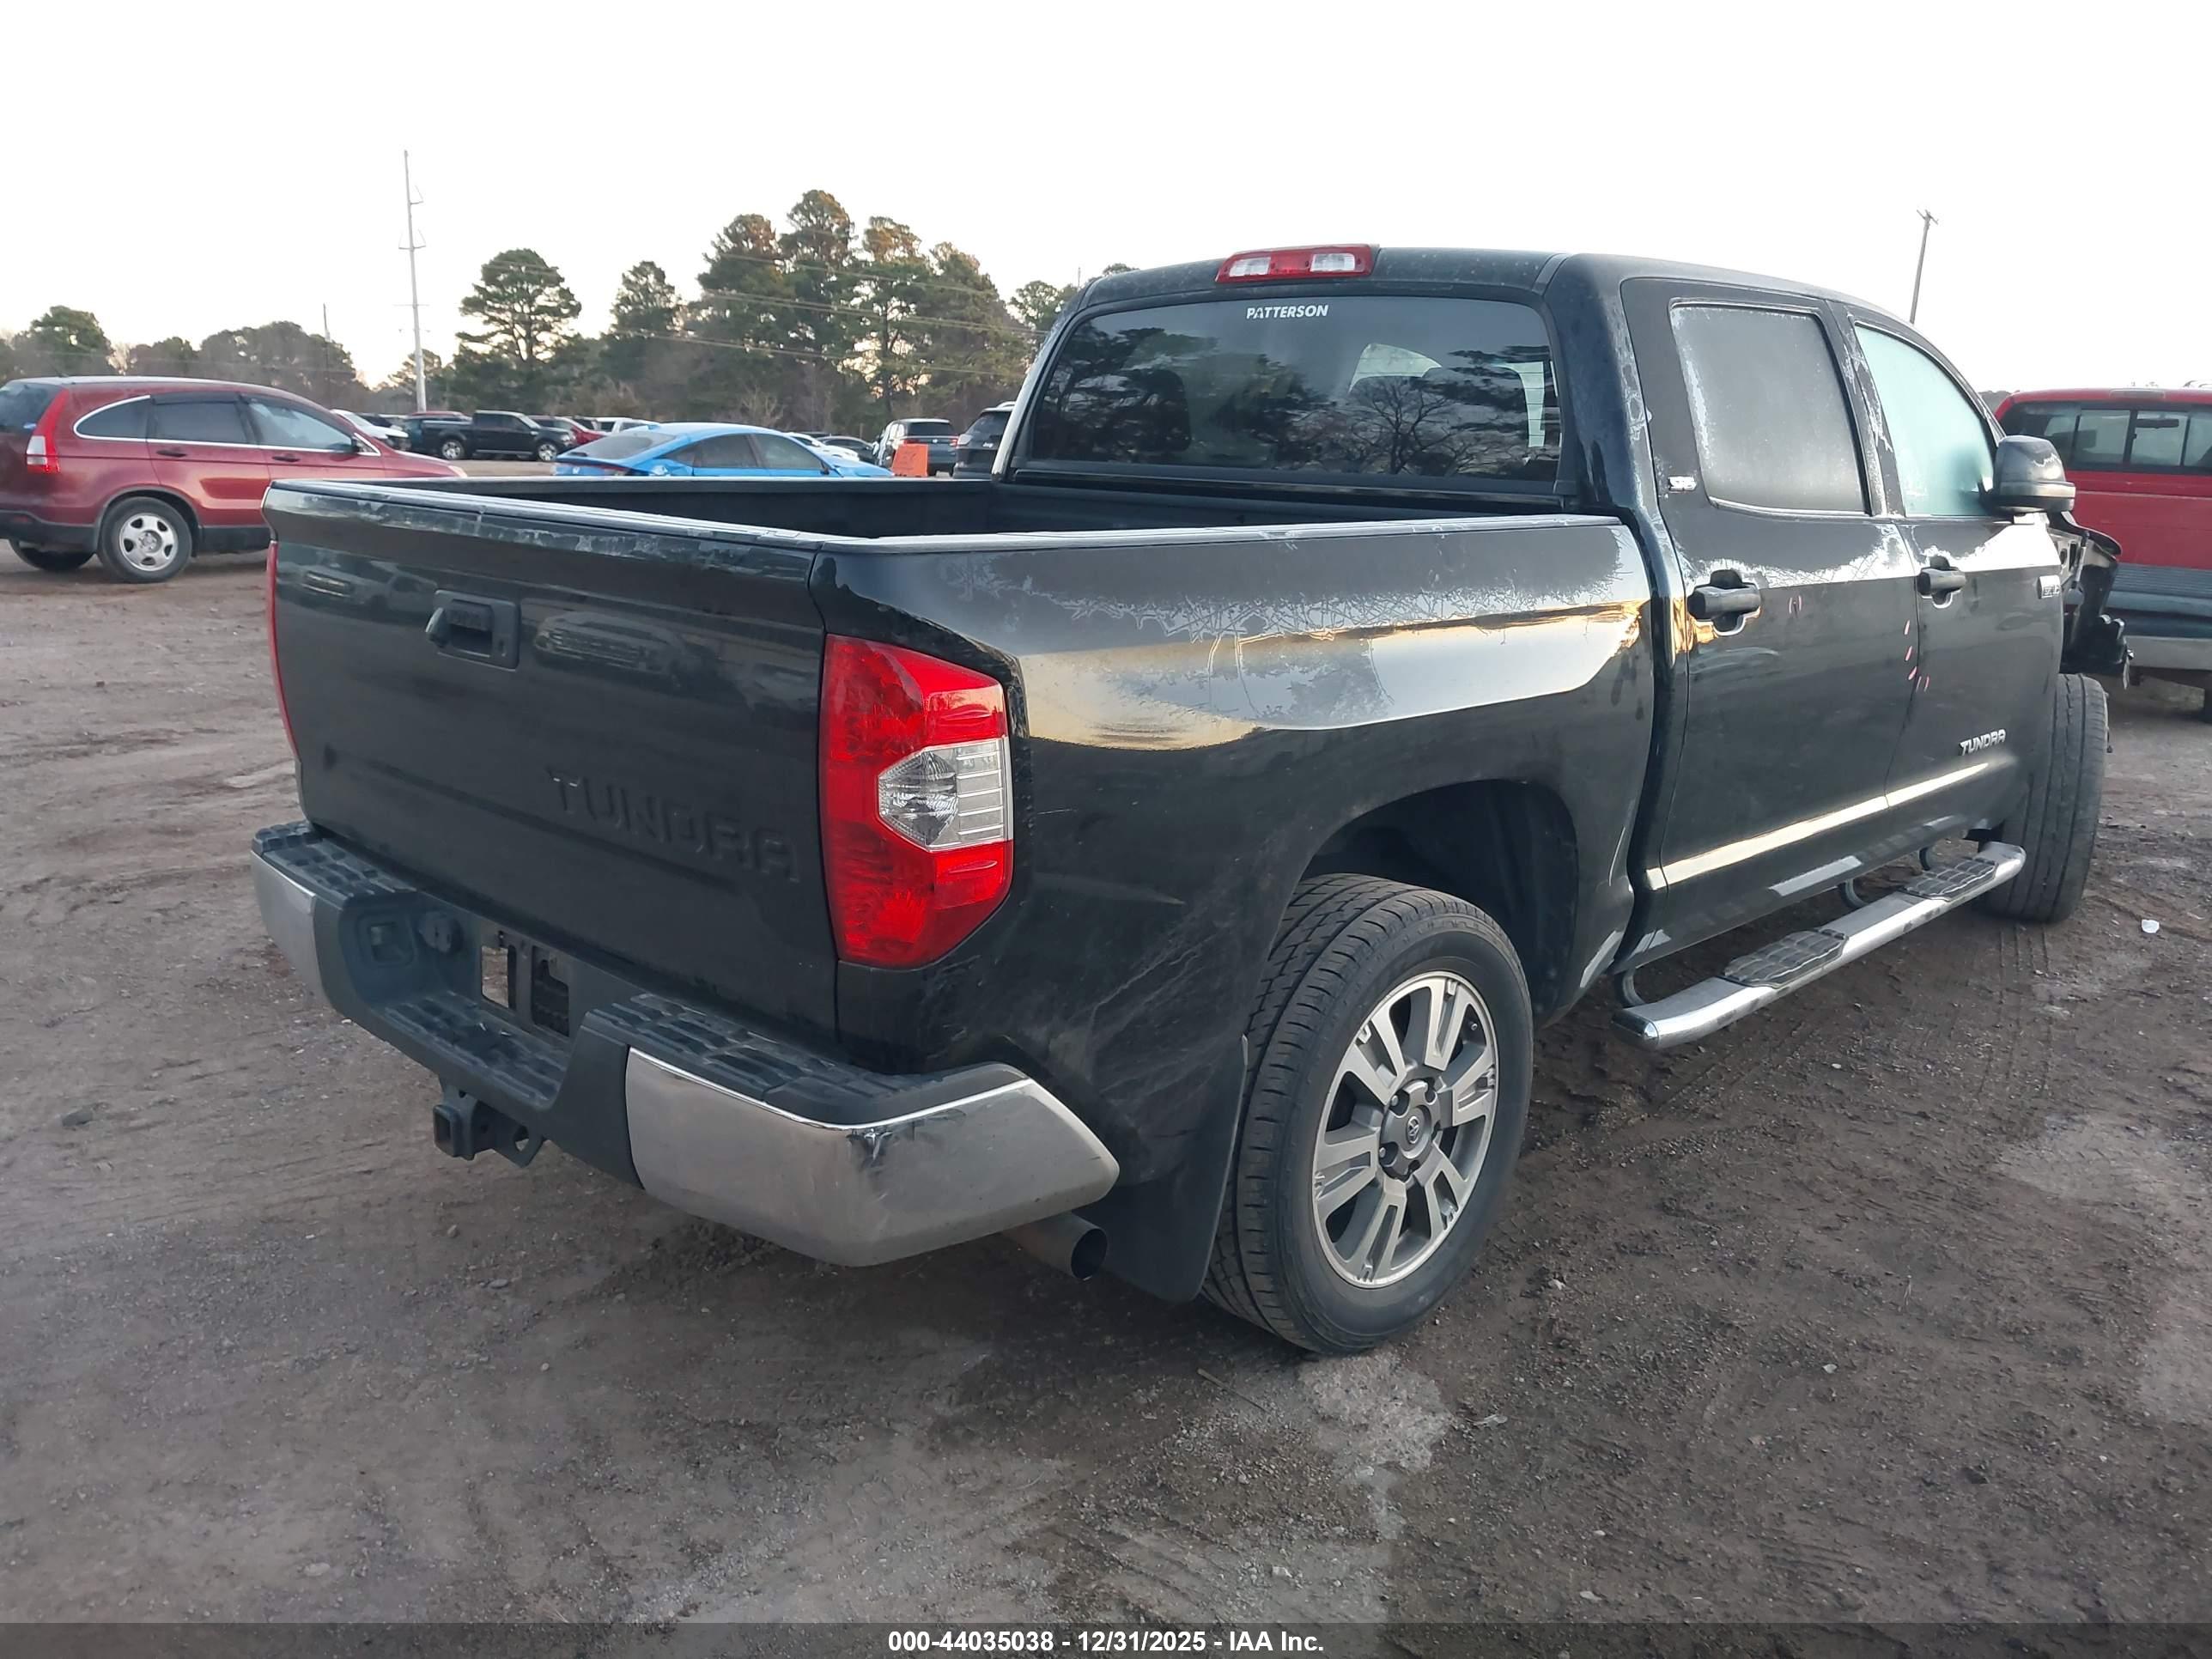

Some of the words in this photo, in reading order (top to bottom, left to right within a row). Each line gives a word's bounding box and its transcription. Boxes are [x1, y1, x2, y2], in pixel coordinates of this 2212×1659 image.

[1246, 304, 1329, 319] PATTERSON
[1960, 728, 2007, 757] TUNDRA
[545, 766, 799, 884] TUNDRA
